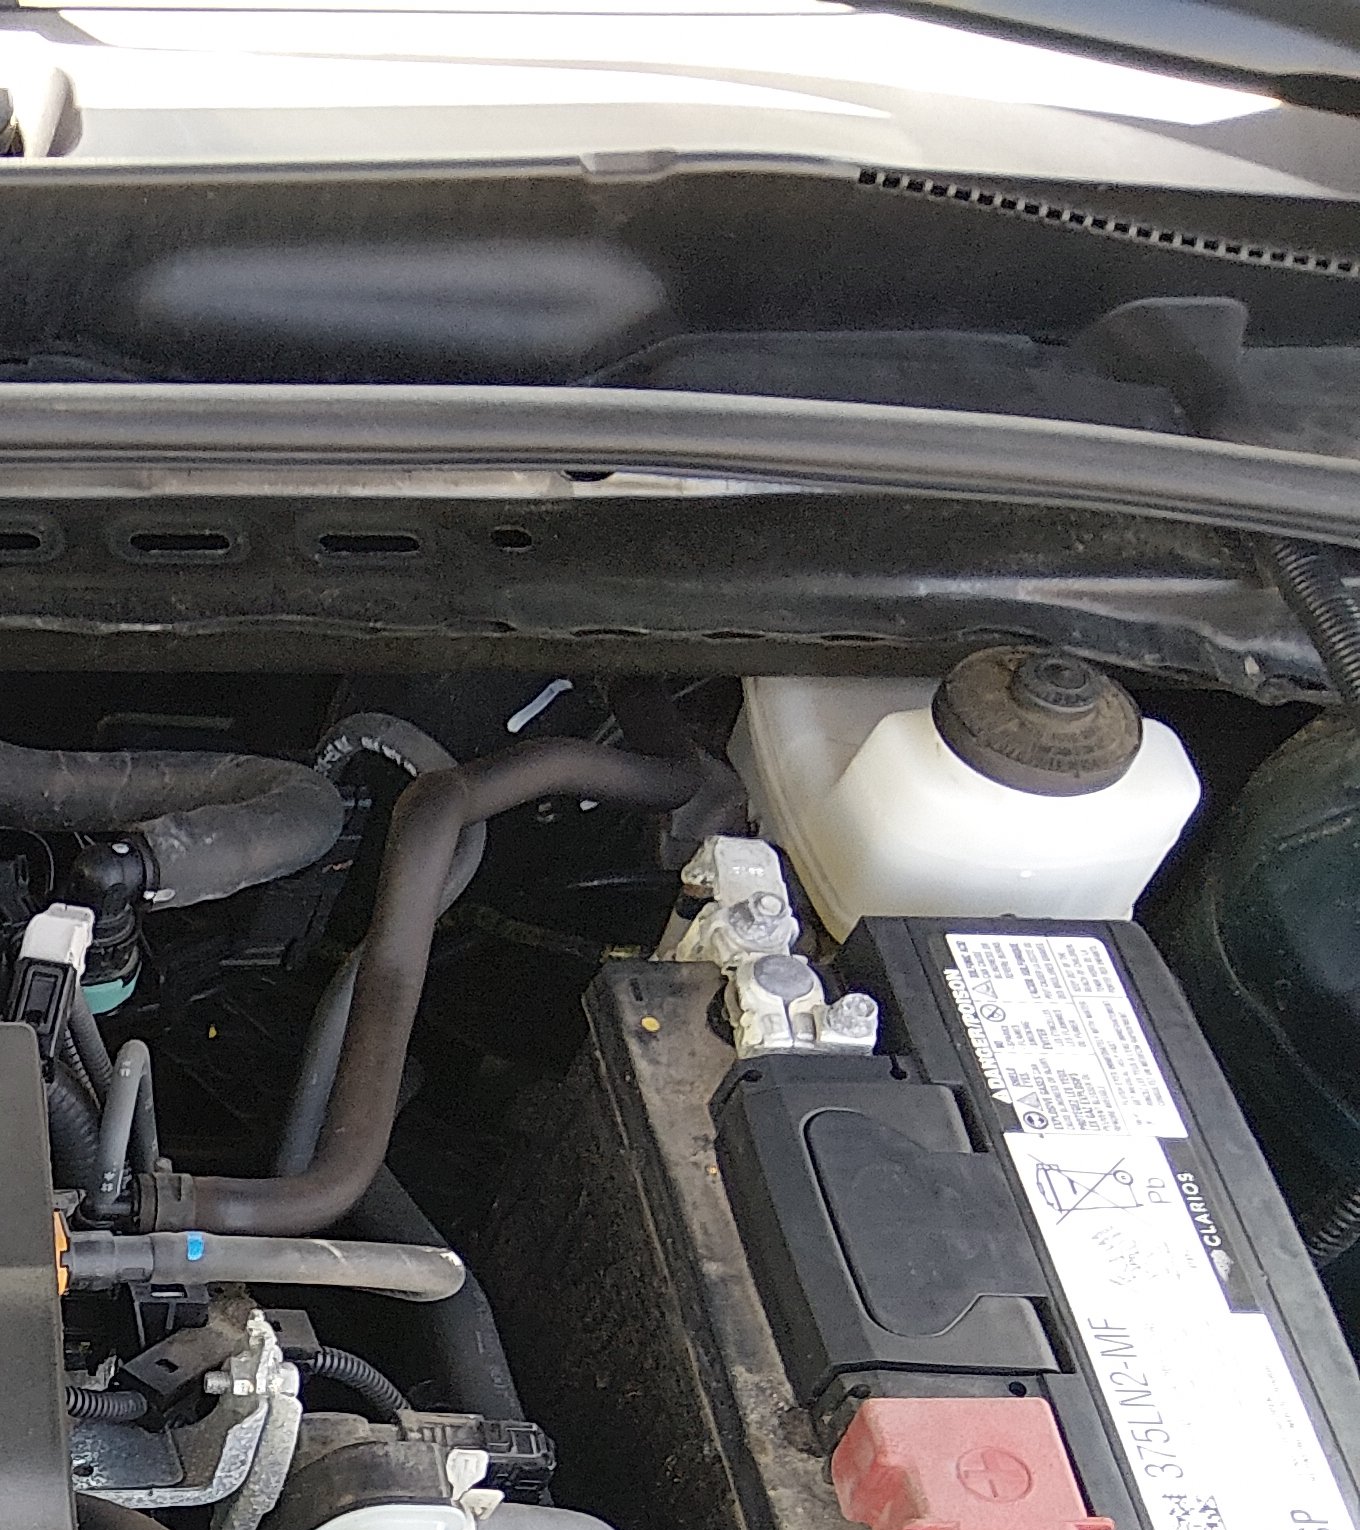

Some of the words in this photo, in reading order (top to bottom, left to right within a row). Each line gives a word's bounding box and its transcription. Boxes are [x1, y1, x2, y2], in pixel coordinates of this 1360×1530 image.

[943, 967, 1006, 1089] DANGER/POISON
[1146, 1177, 1172, 1204] Pb
[1176, 1171, 1222, 1248] CLARIOS
[1088, 1317, 1184, 1479] 375LN2-MF
